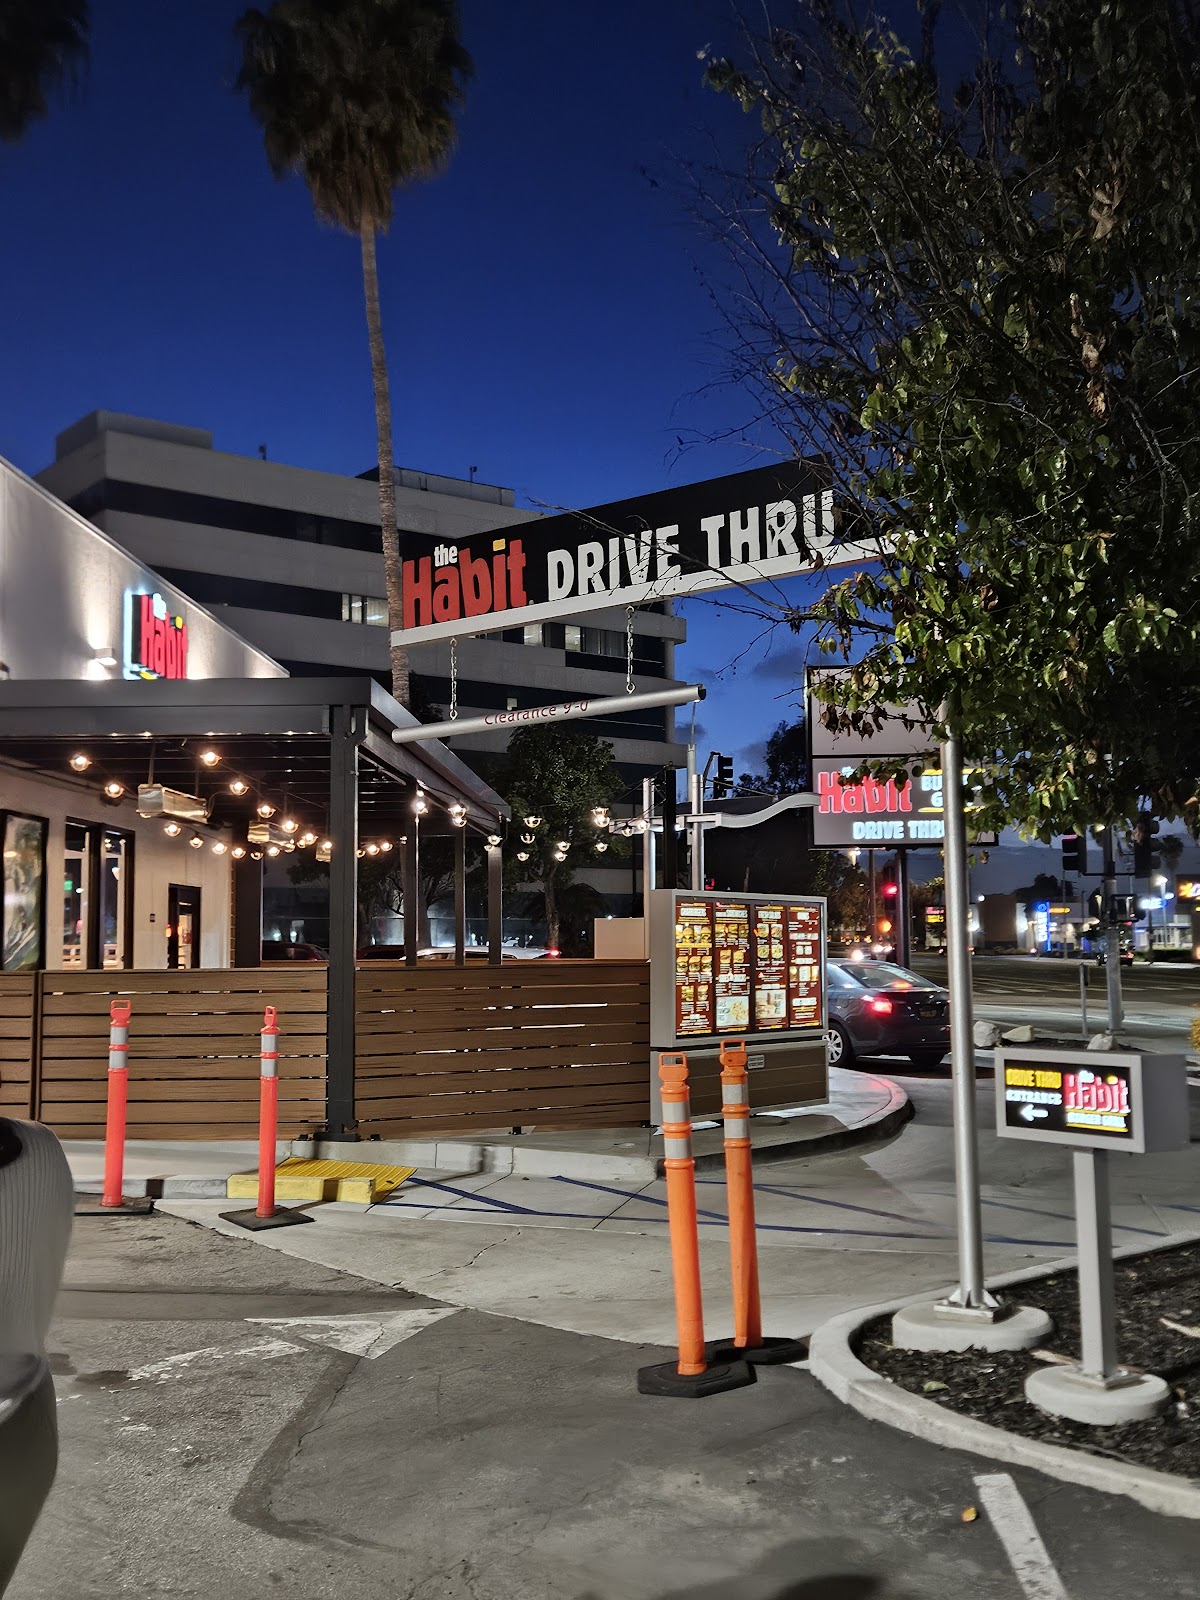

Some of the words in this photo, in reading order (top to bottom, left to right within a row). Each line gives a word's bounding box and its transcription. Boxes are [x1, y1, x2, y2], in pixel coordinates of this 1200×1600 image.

[403, 538, 527, 629] Habit
[547, 524, 681, 601] DRIVE
[701, 490, 835, 568] THRU
[434, 544, 458, 567] the
[141, 594, 188, 679] Habit
[484, 706, 557, 725] Clearance
[818, 771, 913, 813] Habit
[852, 821, 904, 840] DRIVE
[908, 820, 945, 839] THR
[1064, 1073, 1131, 1114] Habit
